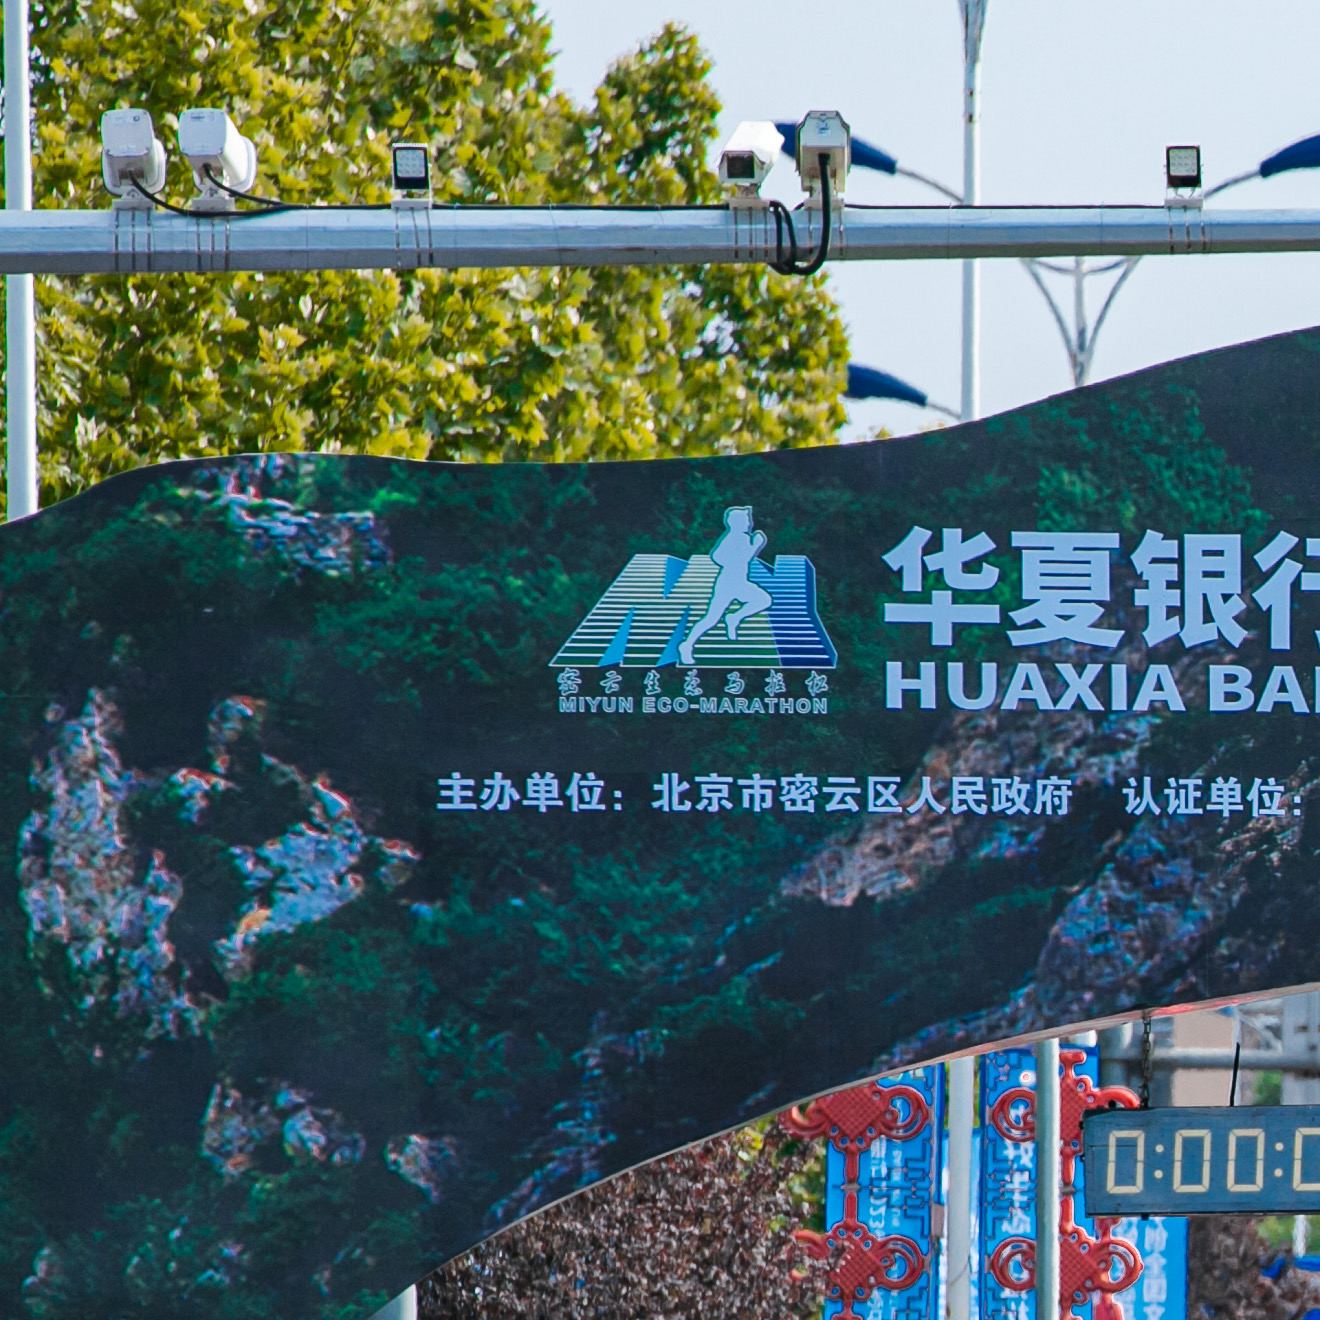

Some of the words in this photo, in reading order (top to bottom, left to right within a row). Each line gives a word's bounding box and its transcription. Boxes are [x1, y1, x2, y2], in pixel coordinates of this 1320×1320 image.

[884, 660, 1185, 713] HUAXIA
[558, 696, 634, 713] MIYUN
[642, 697, 828, 714] ECO-MARATHON
